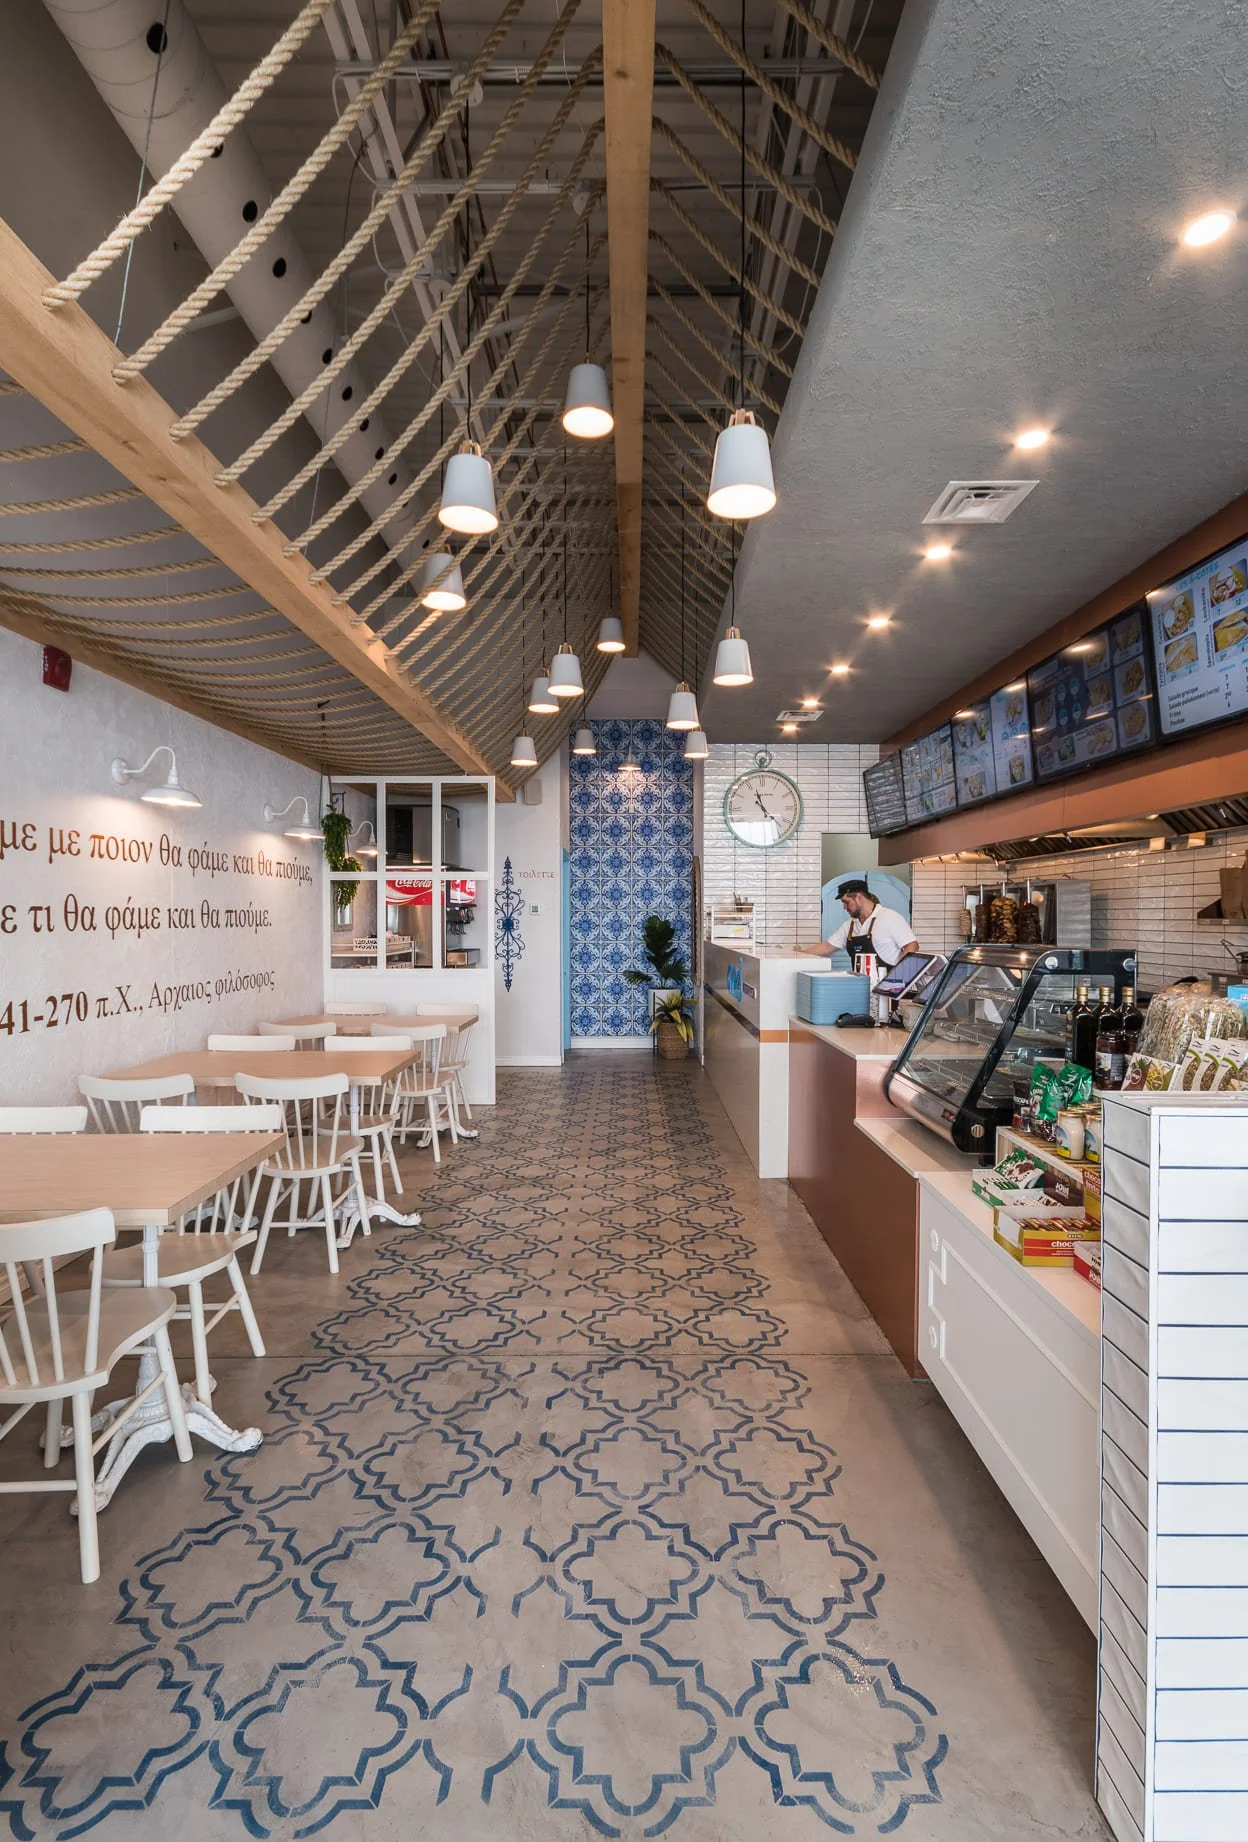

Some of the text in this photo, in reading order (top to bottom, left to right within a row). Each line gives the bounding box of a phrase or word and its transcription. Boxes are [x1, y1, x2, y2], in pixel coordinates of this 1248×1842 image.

[48, 827, 81, 864] με
[89, 833, 153, 864] ποιον
[159, 833, 182, 867] θα
[188, 841, 229, 879] φάμε
[233, 855, 254, 875] και
[257, 850, 273, 877] θα
[275, 857, 313, 886] πιούμε,
[27, 905, 55, 933] τι
[63, 893, 97, 932] θα
[105, 896, 161, 940] φάμε
[167, 907, 196, 929] και
[200, 899, 221, 929] θα
[225, 902, 272, 934] πιούμε.
[0, 991, 88, 1036] 41-270
[215, 969, 275, 1002] φιλόσοφος
